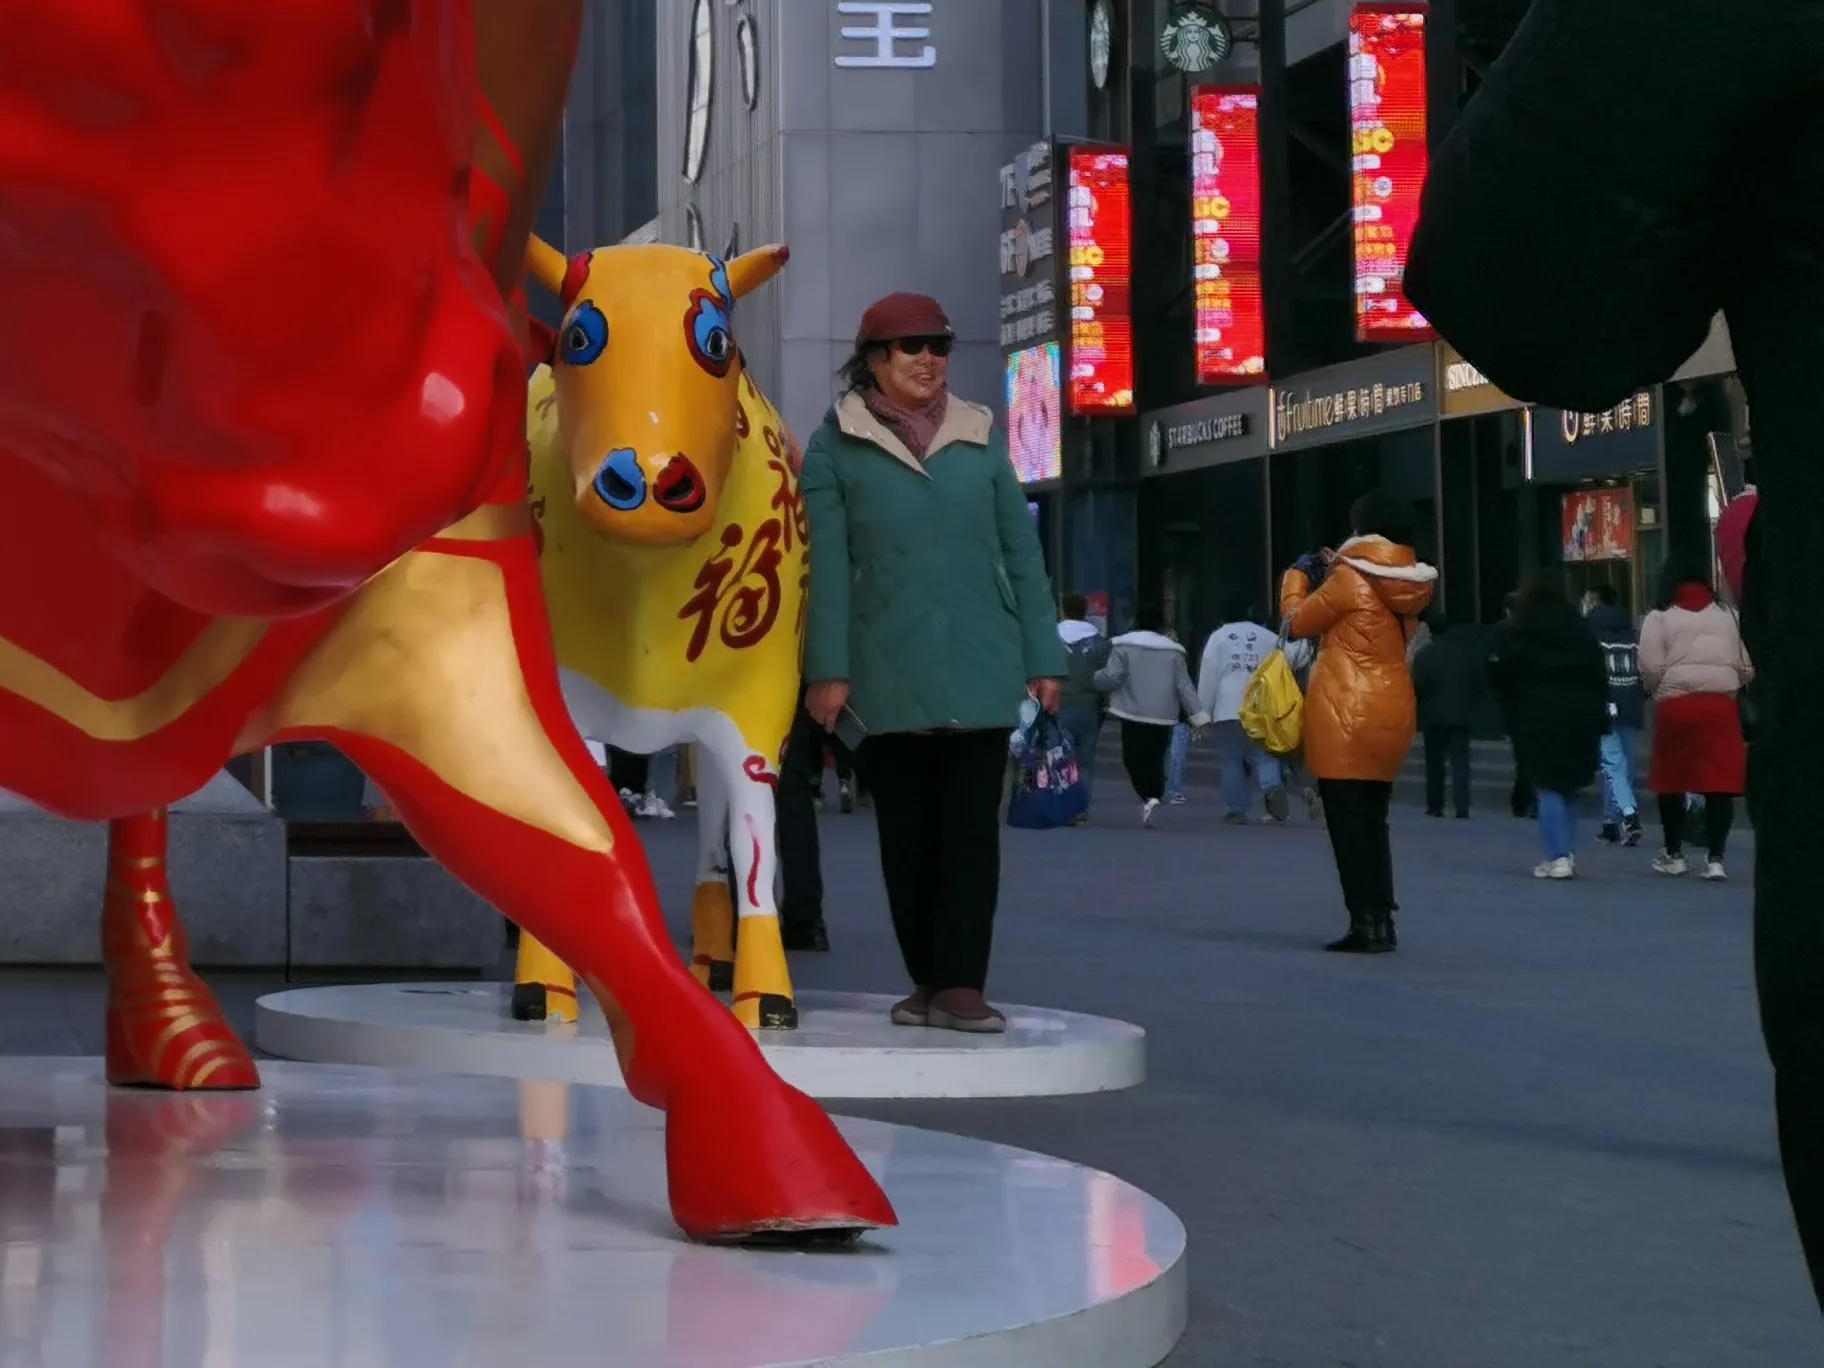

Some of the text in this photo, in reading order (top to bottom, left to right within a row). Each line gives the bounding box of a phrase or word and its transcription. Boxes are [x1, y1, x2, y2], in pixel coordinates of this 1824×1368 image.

[1168, 413, 1242, 449] STARBUCKS COFFEE
[678, 519, 782, 663] 福
